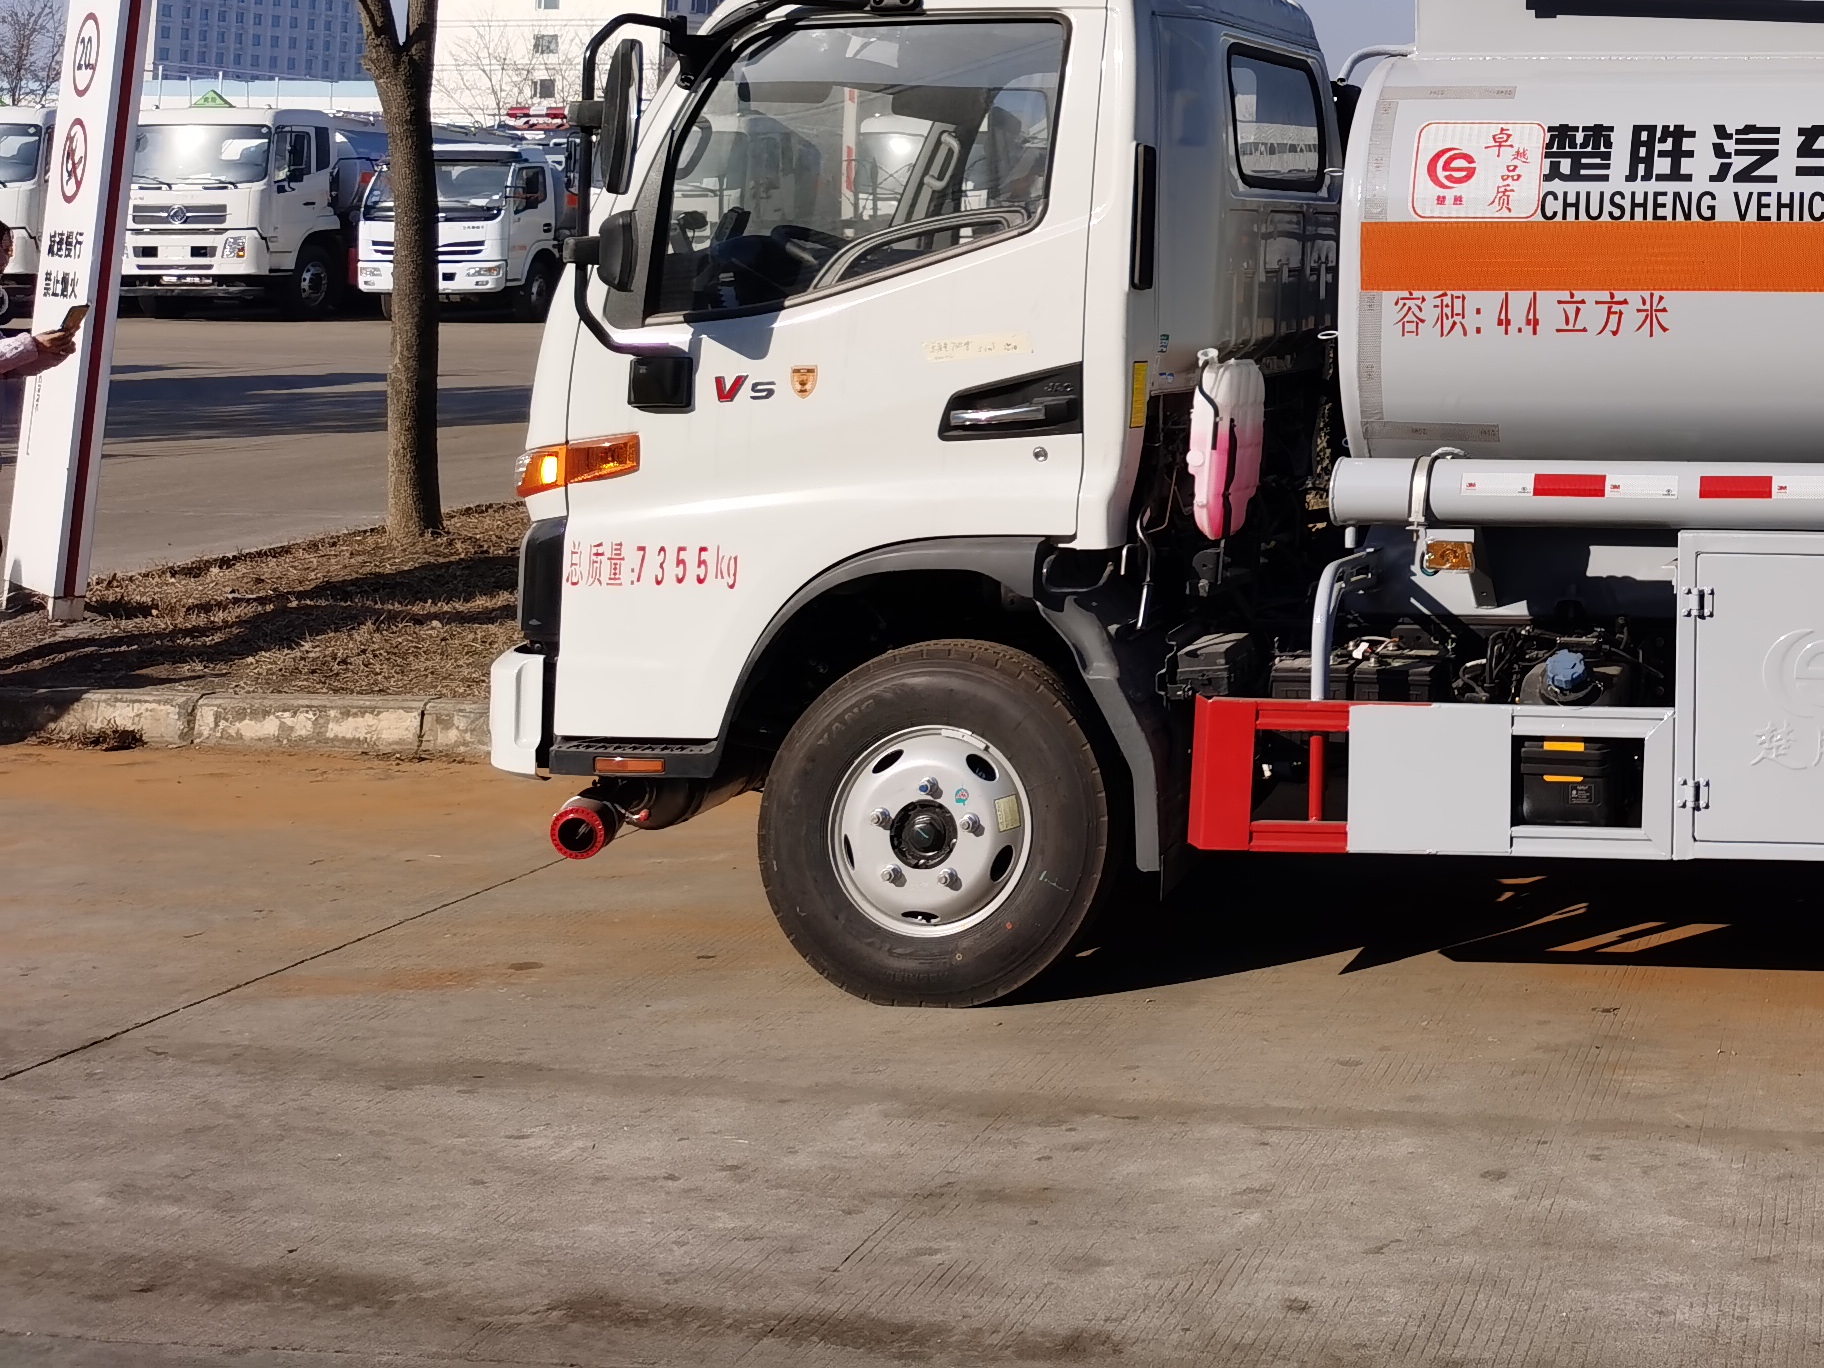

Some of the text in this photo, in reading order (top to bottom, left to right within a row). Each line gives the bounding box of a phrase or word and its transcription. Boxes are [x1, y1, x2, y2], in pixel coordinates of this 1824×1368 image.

[77, 36, 92, 70] 20
[1484, 127, 1532, 213] 卓越品质
[1540, 190, 1717, 221] CHUSHENG
[47, 230, 84, 260] 减速慢行
[43, 270, 79, 300] 禁止烟火
